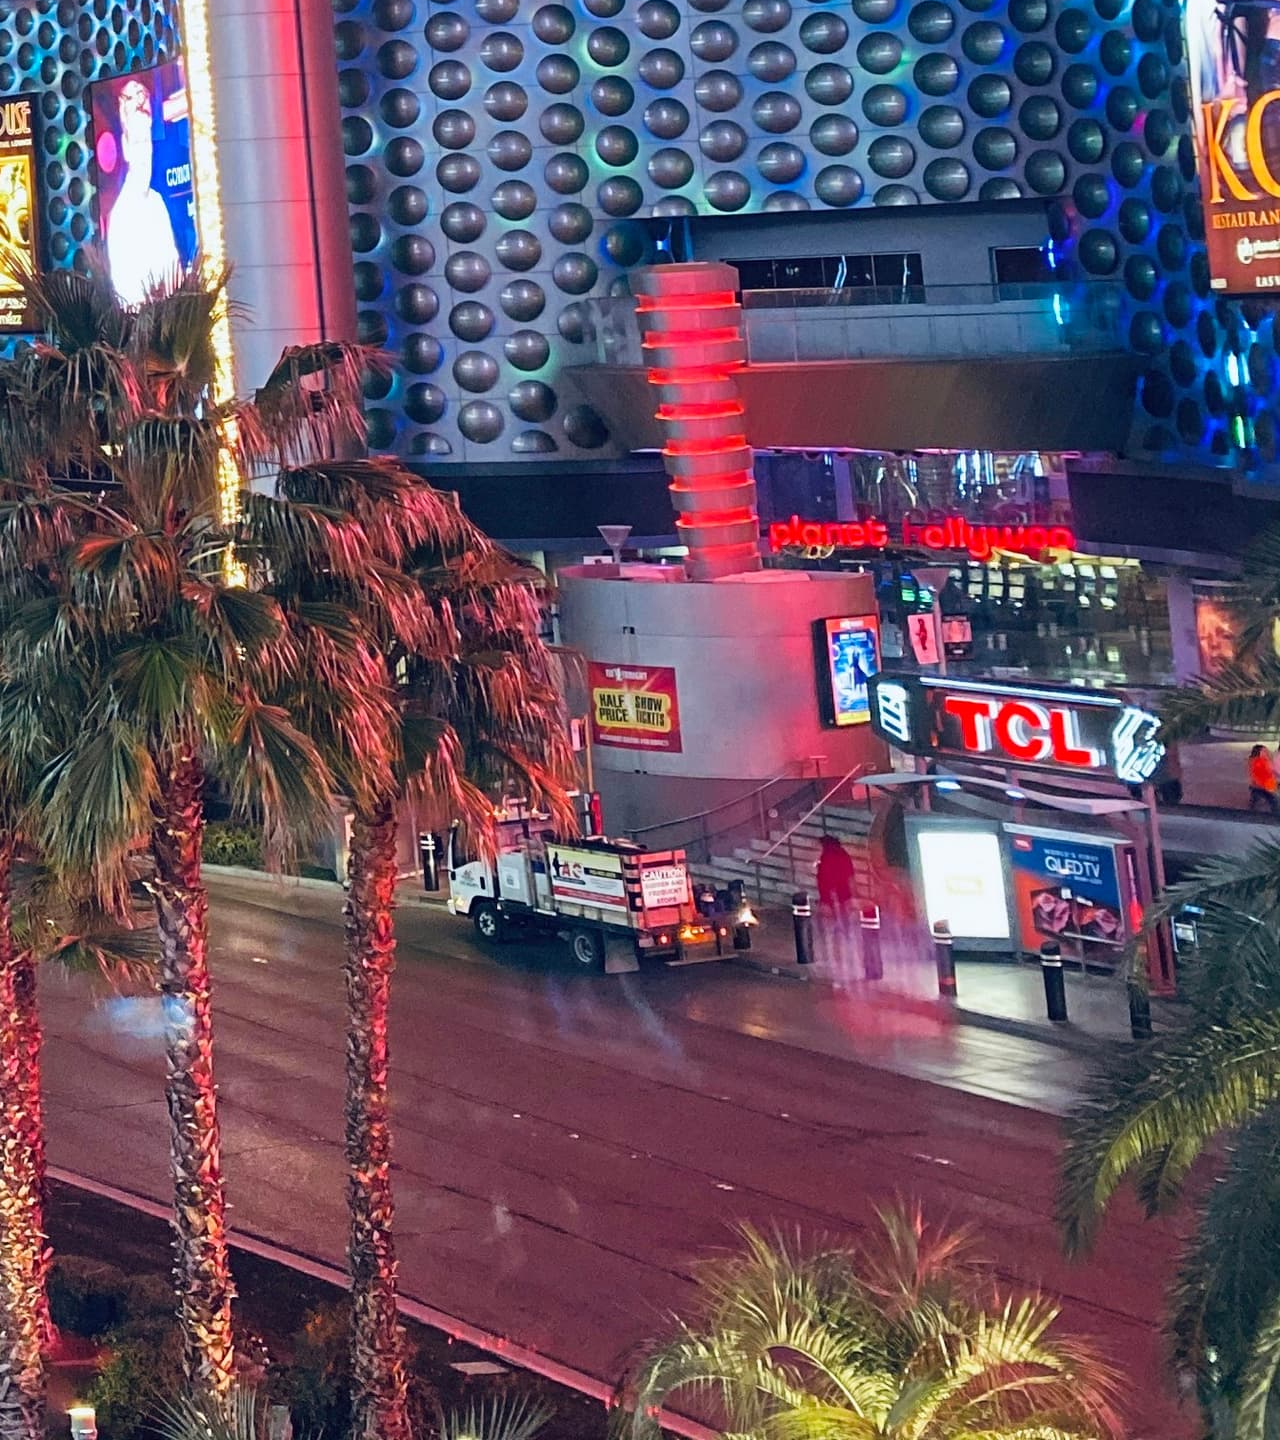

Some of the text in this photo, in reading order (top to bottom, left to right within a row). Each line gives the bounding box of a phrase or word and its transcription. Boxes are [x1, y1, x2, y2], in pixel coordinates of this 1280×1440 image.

[770, 514, 889, 553] planet
[599, 693, 664, 713] HALF SHOW
[599, 707, 666, 728] PRICE TICKETS
[944, 696, 1103, 768] TCL
[642, 868, 684, 882] CAUTION
